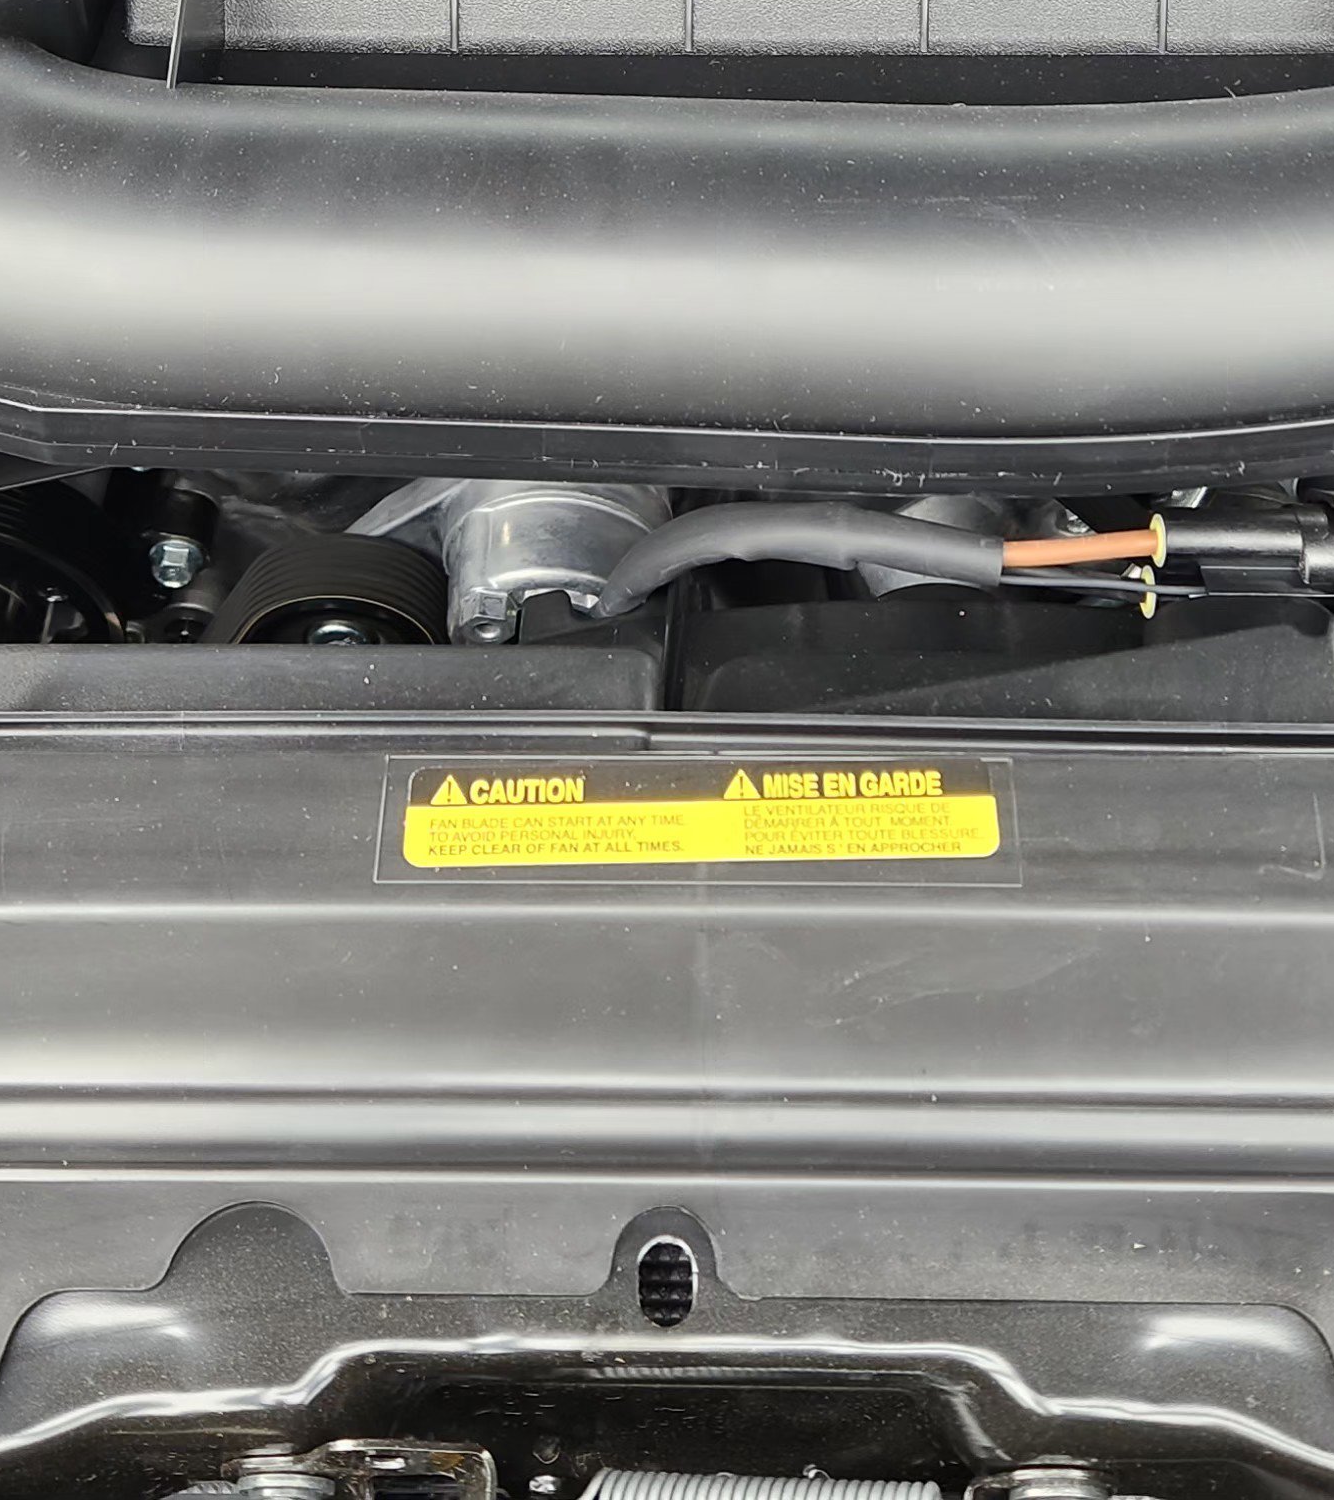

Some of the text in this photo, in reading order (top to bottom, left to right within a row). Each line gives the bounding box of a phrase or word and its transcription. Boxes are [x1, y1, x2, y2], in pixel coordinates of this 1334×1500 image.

[469, 778, 585, 804] CAUTION
[762, 770, 943, 799] MISE EN GARDE
[744, 802, 951, 817] LE VENTILATEUR RISQUE DE
[430, 818, 458, 829] FAN
[461, 817, 509, 829] BLADE
[512, 816, 544, 828] CAN
[548, 816, 593, 828] START
[596, 815, 613, 827] AT
[617, 815, 647, 826] ANY
[844, 816, 881, 828] TOUT
[430, 831, 449, 843] TO
[452, 830, 496, 842] AVOID
[500, 828, 579, 842] PERSONAL
[745, 831, 786, 843] POUR
[847, 828, 896, 841] TOUTE
[428, 840, 685, 856] KEEP CLEAR OF FAN AT ALL TIMES.
[745, 844, 764, 856] NE
[768, 843, 823, 855] JAMAIS
[870, 841, 962, 853] APPROCHER
